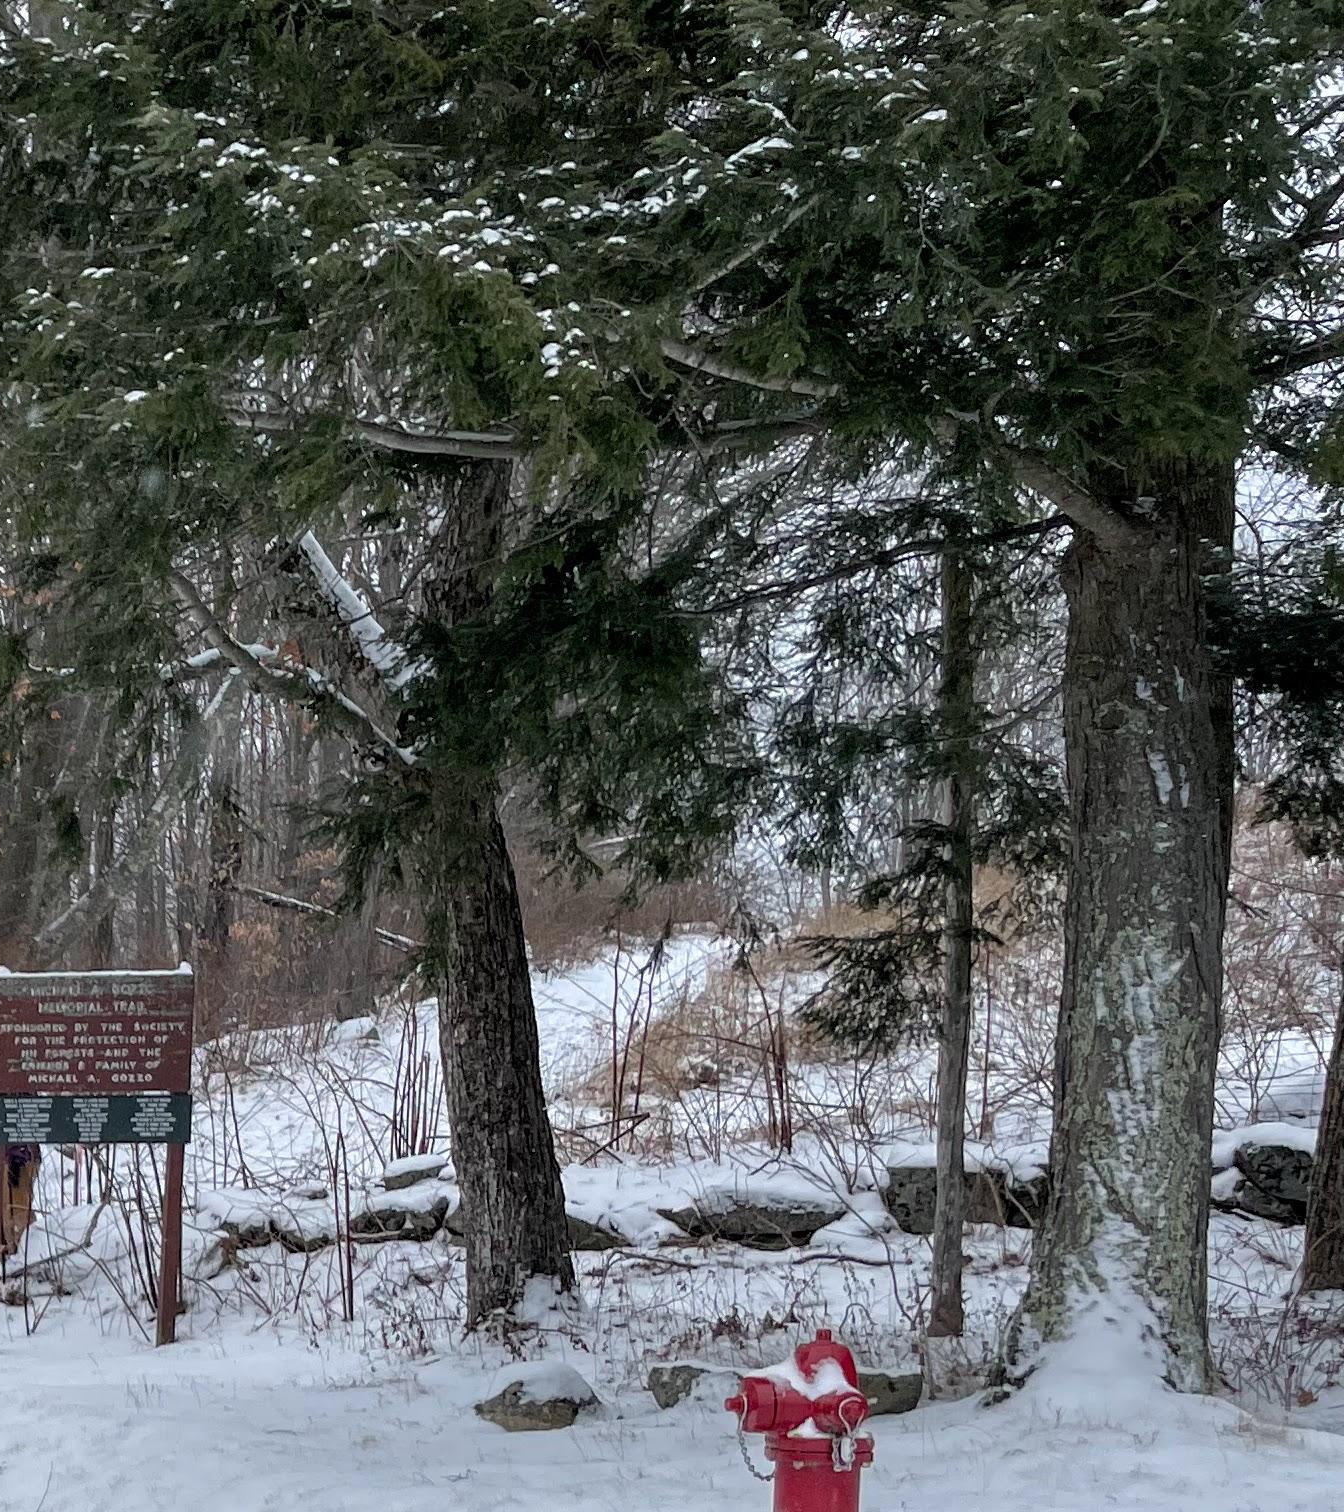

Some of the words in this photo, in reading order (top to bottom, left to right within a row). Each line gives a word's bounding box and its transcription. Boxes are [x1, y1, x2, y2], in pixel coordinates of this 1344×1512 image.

[74, 1023, 88, 1032] BY
[100, 1022, 123, 1032] THE
[133, 1021, 185, 1032] SOCIETY
[14, 1035, 37, 1045] FOR
[44, 1035, 66, 1045] THE
[73, 1035, 146, 1045] PROTECTION
[153, 1035, 168, 1044] OF
[104, 1048, 129, 1057] AND
[139, 1047, 162, 1057] THE
[95, 1061, 137, 1070] FAMILY
[145, 1060, 161, 1069] OF
[28, 1074, 78, 1083] MICHAEL
[87, 1074, 100, 1083] A.
[111, 1073, 153, 1083] GOZZO
